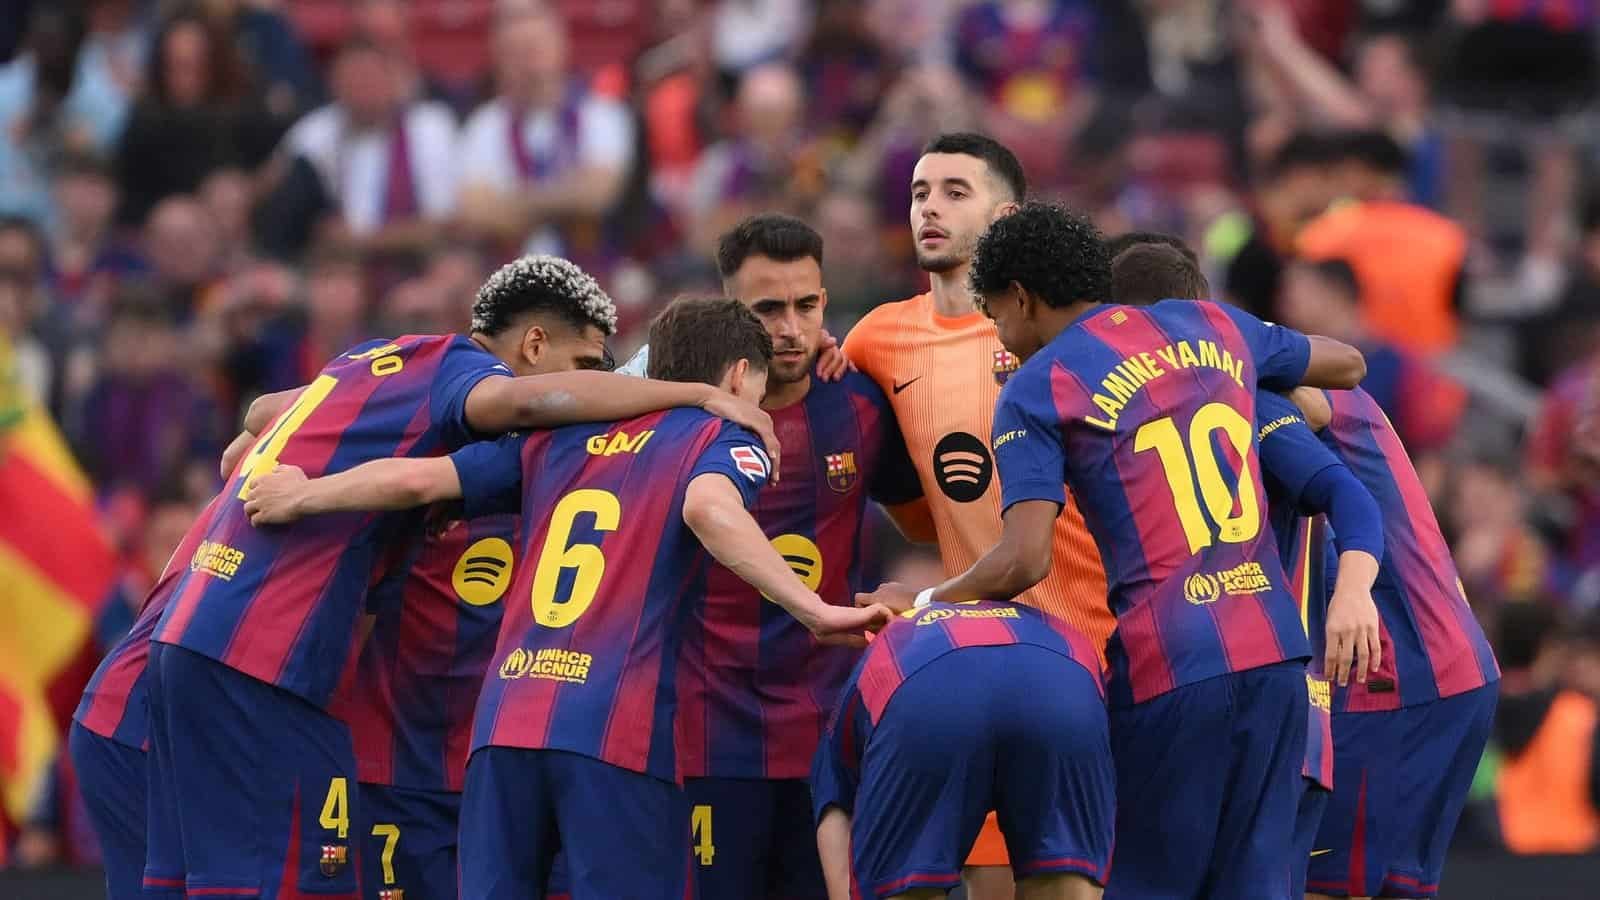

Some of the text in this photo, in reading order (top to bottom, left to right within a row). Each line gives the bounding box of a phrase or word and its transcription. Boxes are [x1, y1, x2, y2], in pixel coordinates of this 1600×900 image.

[1085, 340, 1245, 431] LAMINE YAMAL
[586, 430, 656, 456] GAVI
[1134, 402, 1261, 555] 10
[531, 488, 622, 628] 6
[530, 661, 589, 679] ACNUR
[536, 648, 592, 667] UNHCR
[319, 777, 349, 838] 4
[691, 805, 715, 866] 4
[372, 824, 401, 884] 7
